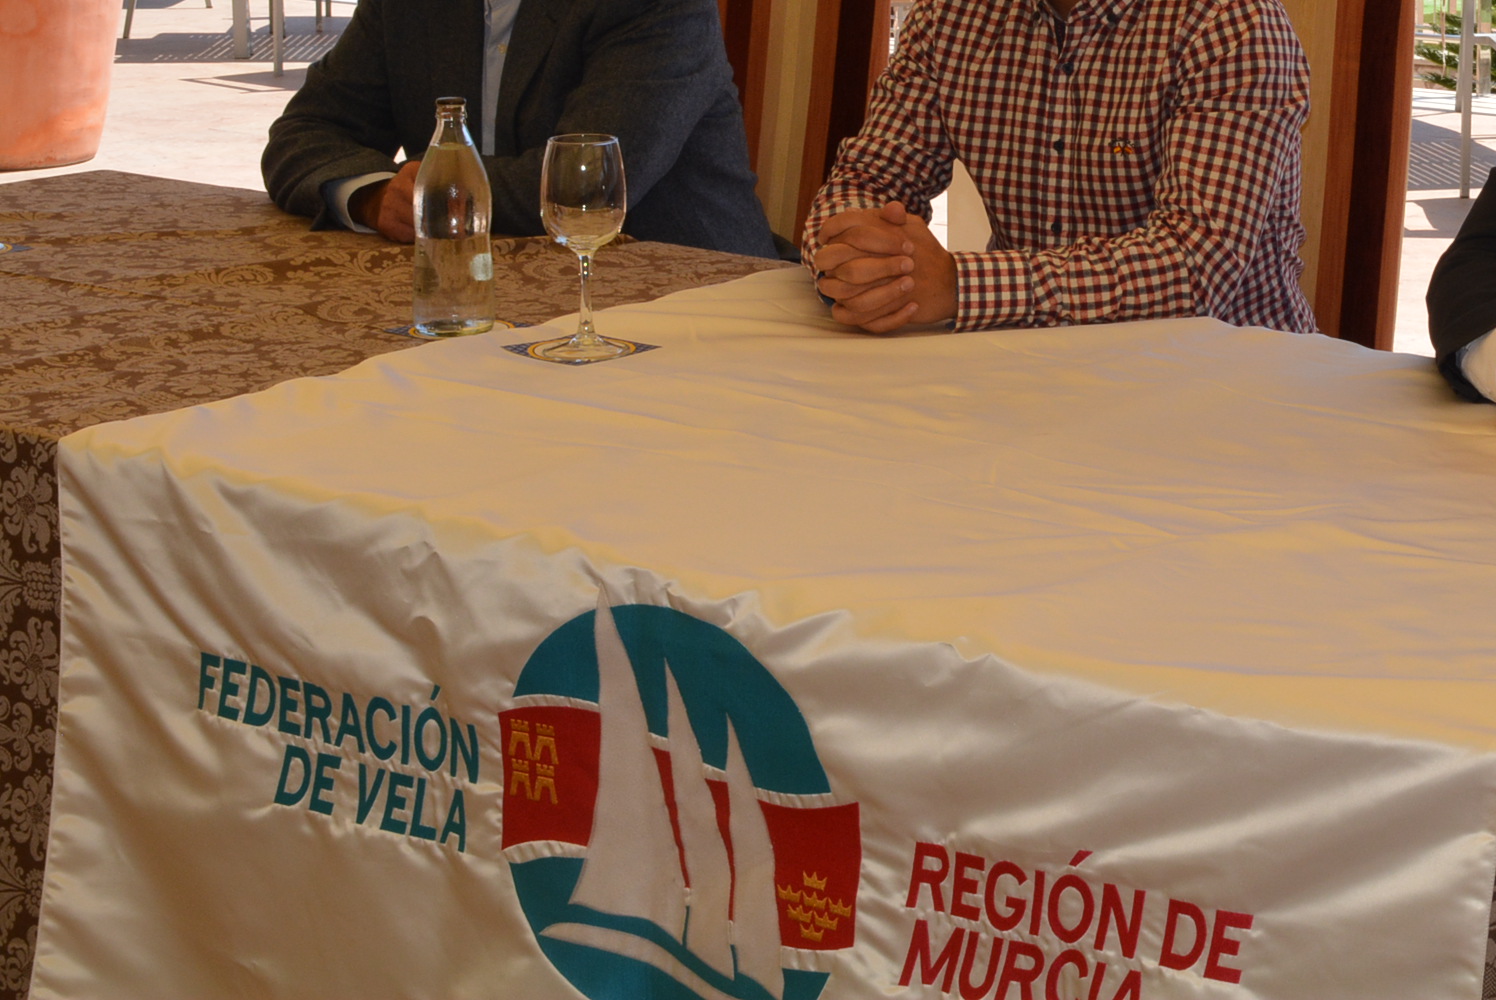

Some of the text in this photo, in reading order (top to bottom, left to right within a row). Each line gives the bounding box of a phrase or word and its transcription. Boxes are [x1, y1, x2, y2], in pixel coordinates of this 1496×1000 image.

[197, 651, 480, 784] FEDERACIÓN
[273, 744, 467, 853] DE VELA
[904, 841, 1255, 984] REGIÓN DE
